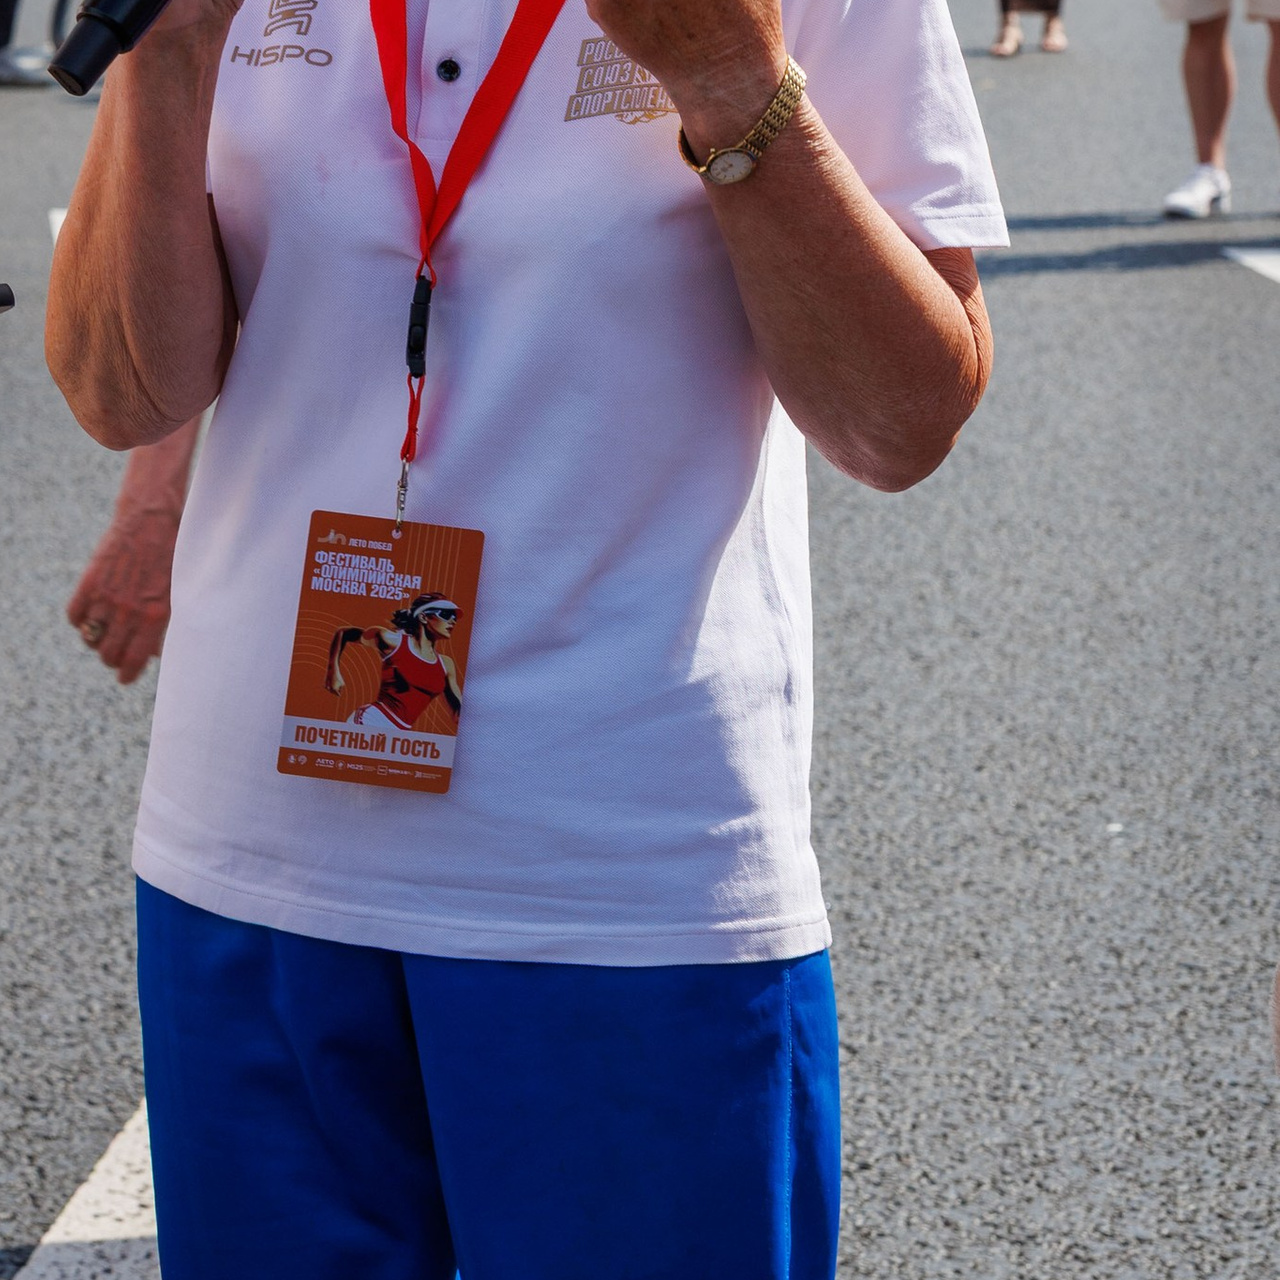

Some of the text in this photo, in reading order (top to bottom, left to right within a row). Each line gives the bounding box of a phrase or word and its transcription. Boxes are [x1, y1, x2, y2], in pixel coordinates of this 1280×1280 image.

[230, 45, 333, 67] HISPO
[581, 62, 633, 90] СОЮЗ
[348, 538, 393, 552] ЛЕТО ПОБЕД
[314, 550, 395, 573] ФЕСТИВАЛЬ
[311, 576, 410, 601] МОСКВА 2025»
[313, 564, 422, 589] «ОЛИМПИЙСКАЯ
[294, 725, 441, 759] ПОЧЕТНЫЙ ГОСТЬ
